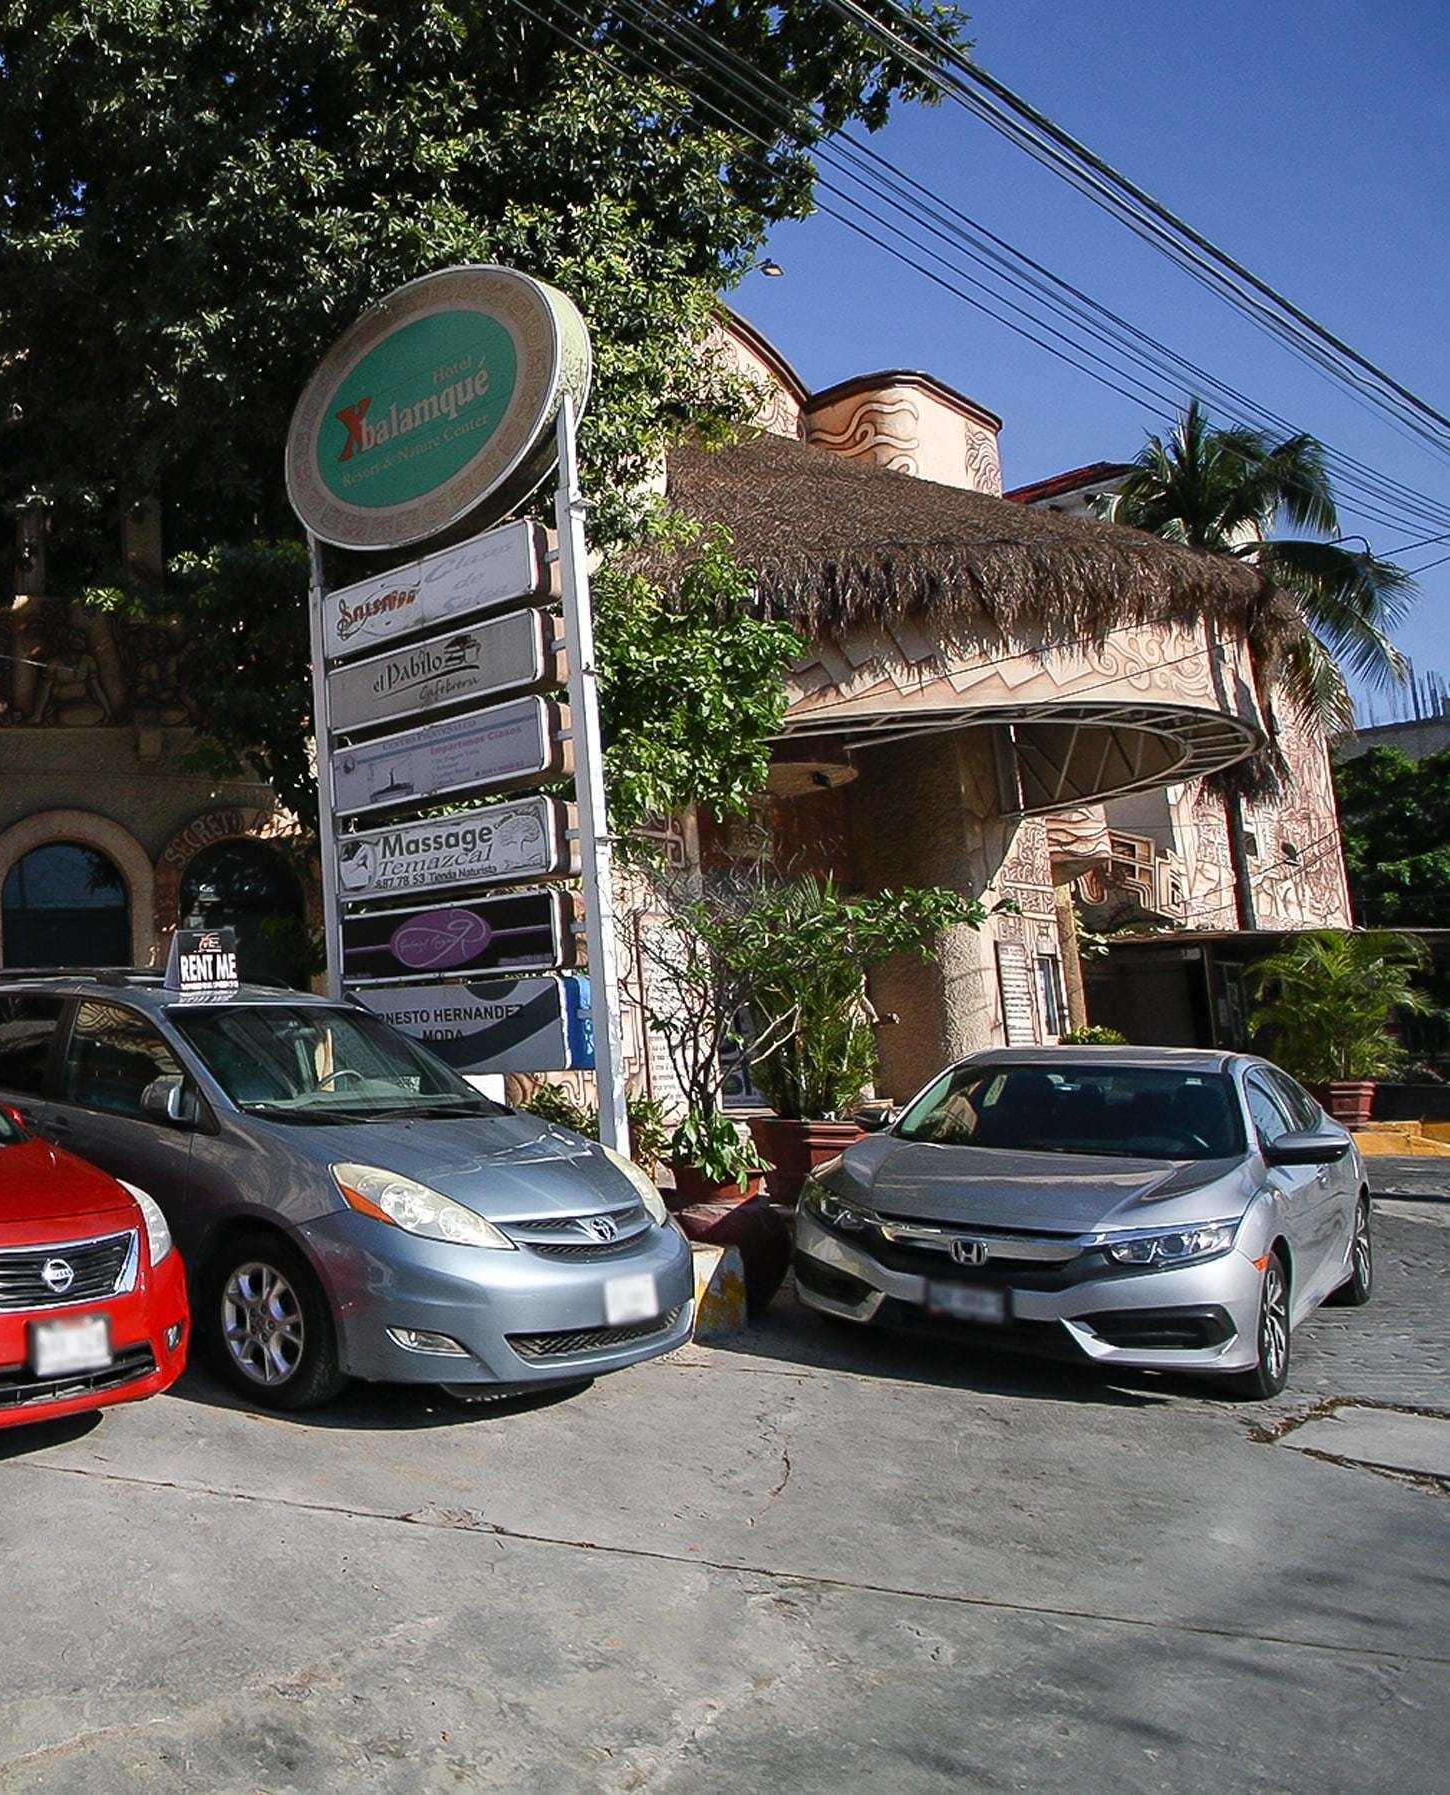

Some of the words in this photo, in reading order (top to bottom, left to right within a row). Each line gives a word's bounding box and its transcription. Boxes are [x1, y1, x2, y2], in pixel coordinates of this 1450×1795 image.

[382, 825, 494, 860] Massage
[378, 844, 494, 877] Temazcal
[412, 872, 426, 885] 53
[180, 954, 213, 982] RENT
[216, 953, 238, 980] ME
[423, 1029, 464, 1041] MODA
